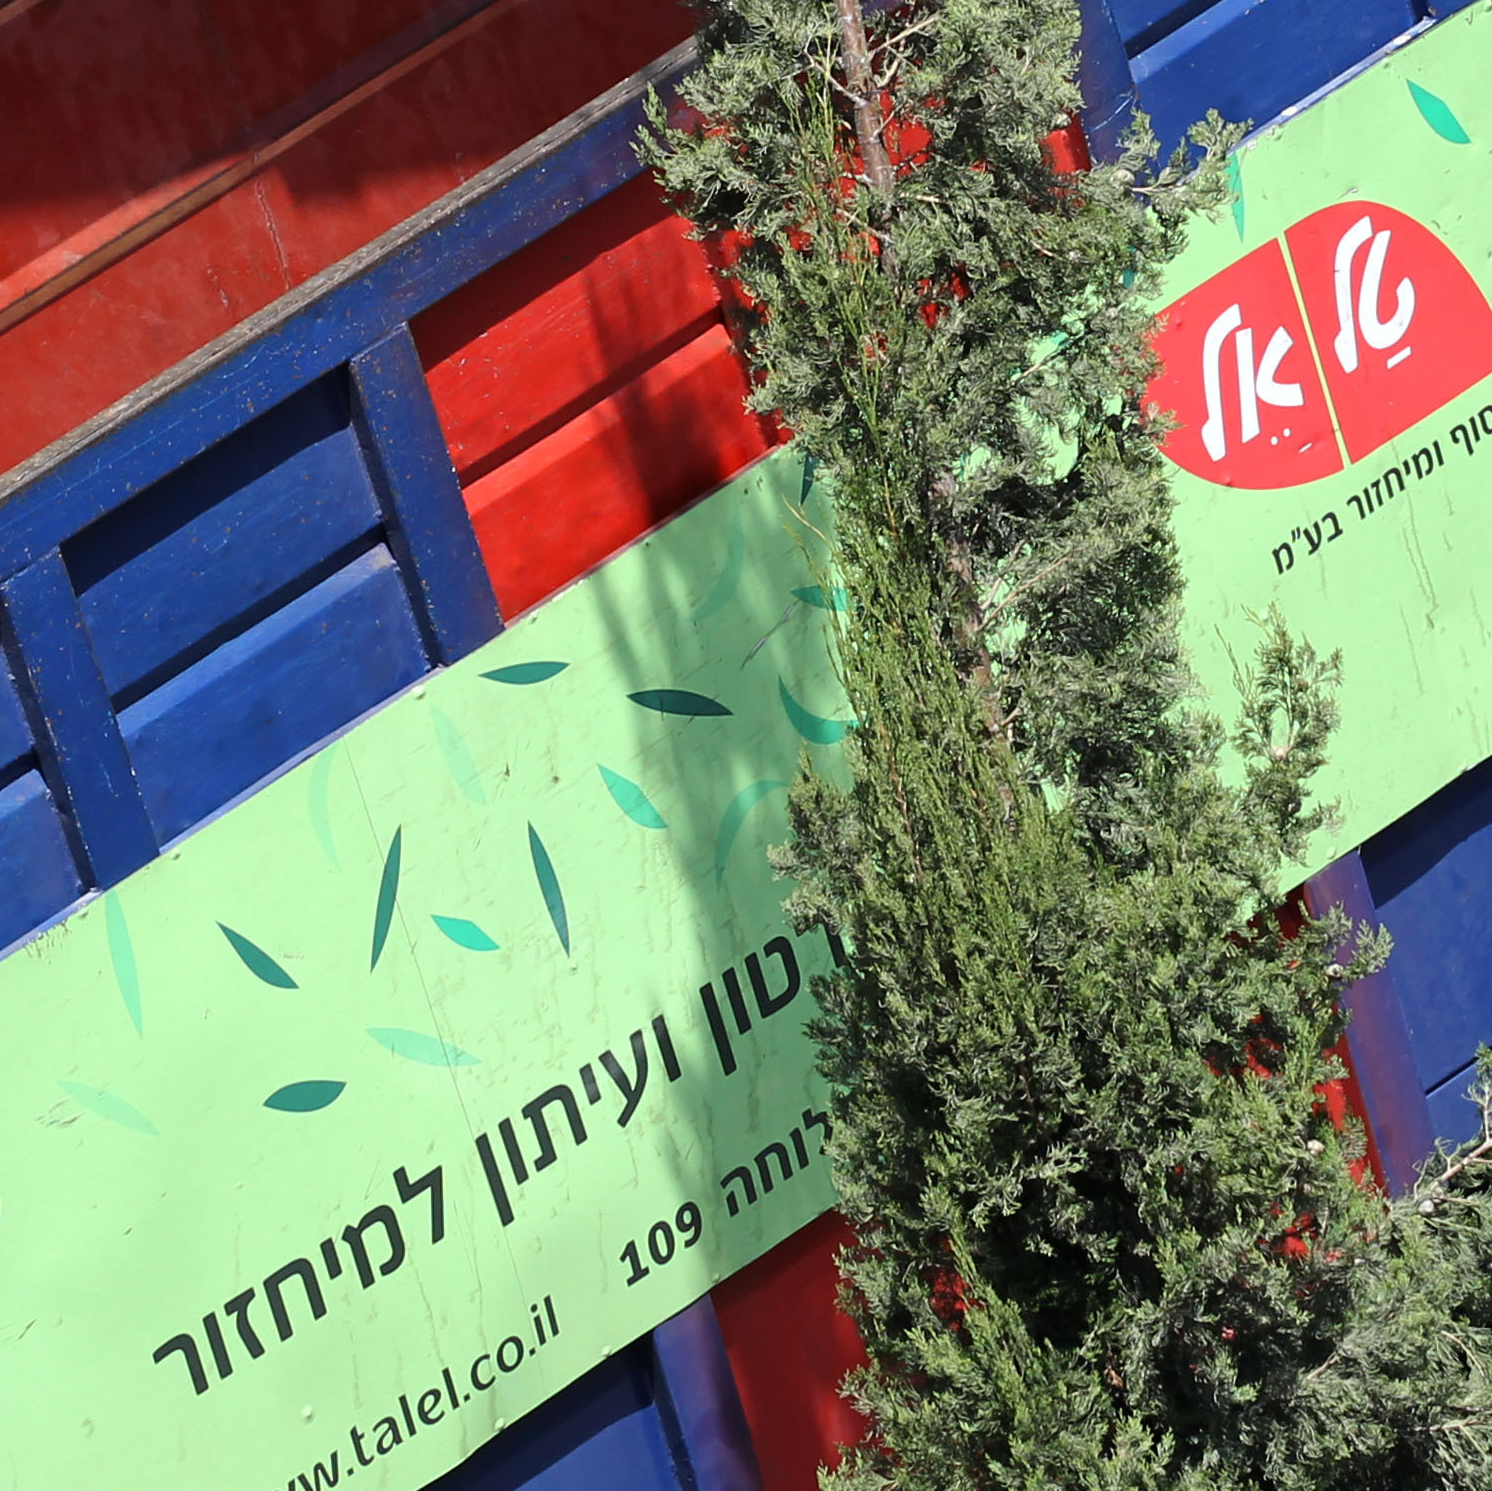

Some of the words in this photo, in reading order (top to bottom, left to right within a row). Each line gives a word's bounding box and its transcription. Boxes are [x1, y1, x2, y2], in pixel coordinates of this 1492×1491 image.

[1272, 512, 1343, 574] בע"מ
[1347, 441, 1444, 519] ומיחזור
[700, 907, 848, 1077] רטון
[475, 1015, 682, 1227] ועיתון
[720, 1107, 835, 1218] לוחה
[152, 1165, 445, 1395] למיחזור
[620, 1201, 702, 1286] 109
[275, 1296, 559, 1491] w.talel.co.il
